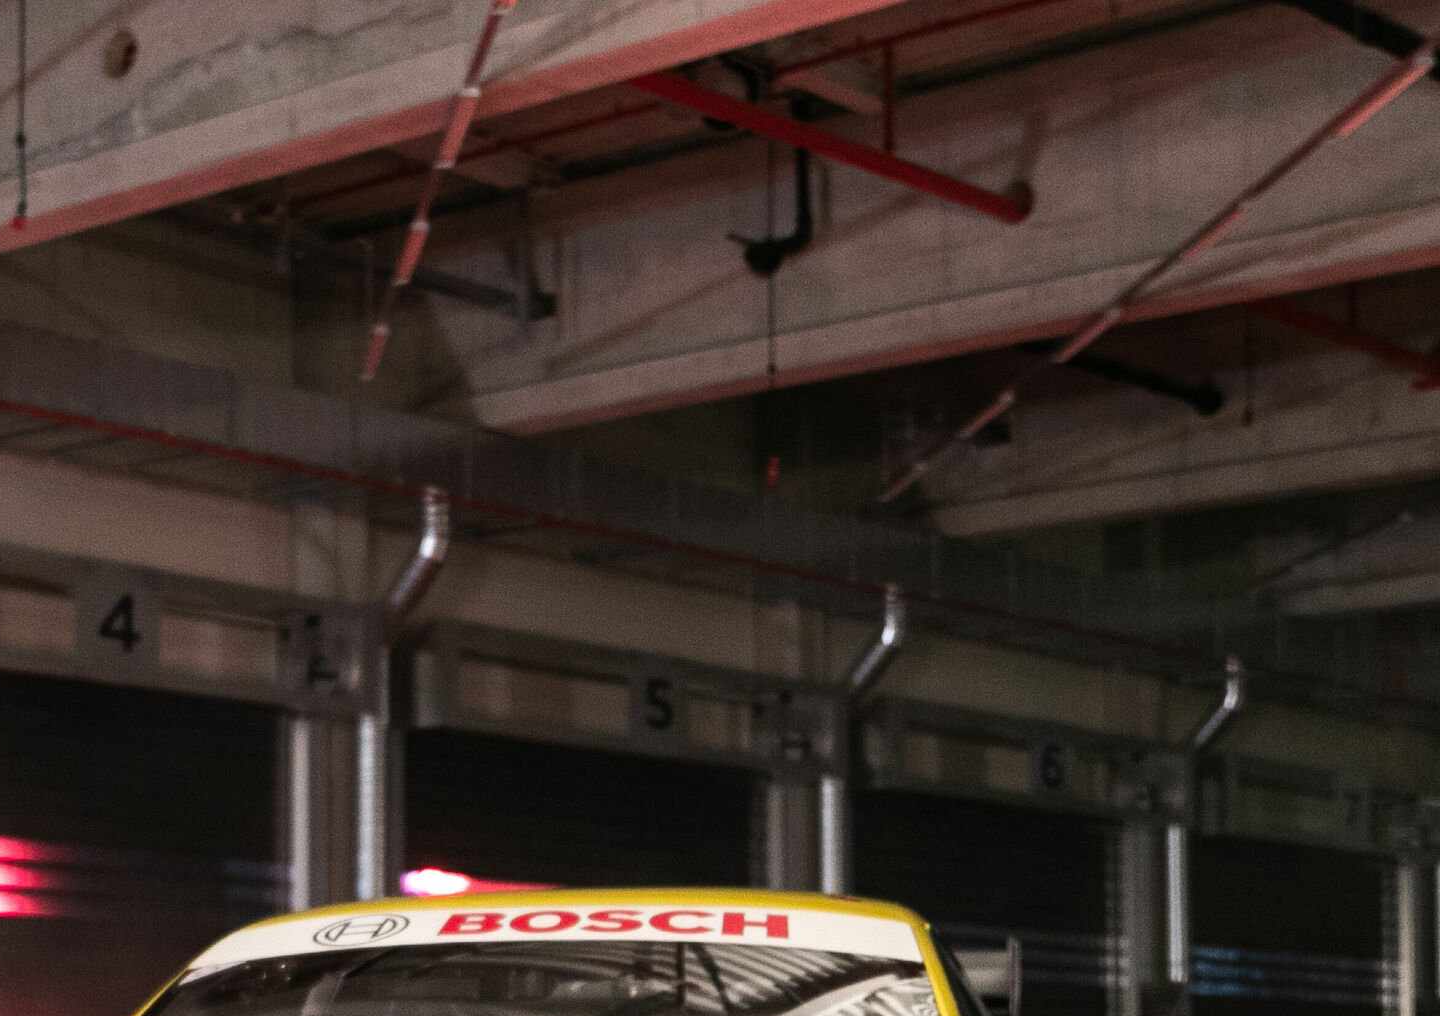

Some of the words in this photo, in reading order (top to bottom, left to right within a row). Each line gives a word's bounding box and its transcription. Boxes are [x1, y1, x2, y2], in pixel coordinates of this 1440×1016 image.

[100, 594, 141, 652] 4
[646, 678, 673, 730] 5
[1041, 746, 1064, 790] 6
[437, 910, 790, 939] BOSCH
